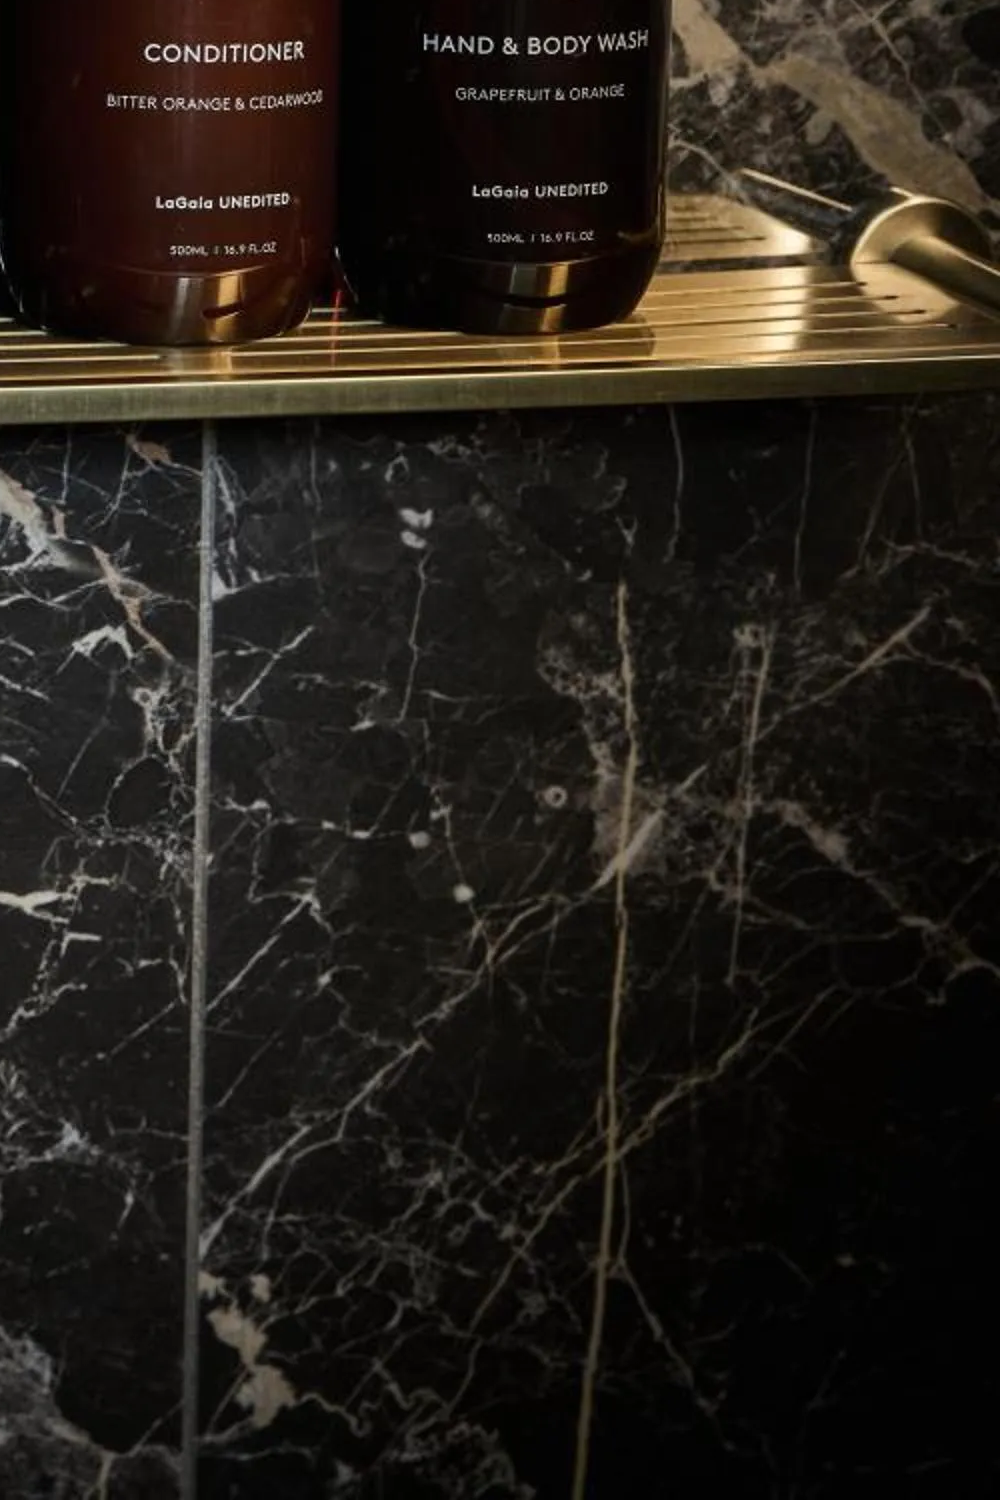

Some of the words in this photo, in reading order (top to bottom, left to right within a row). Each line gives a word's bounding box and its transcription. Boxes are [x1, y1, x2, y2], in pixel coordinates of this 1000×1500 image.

[422, 33, 495, 55] HAND
[502, 36, 520, 56] &
[526, 34, 592, 55] BODY
[598, 29, 649, 53] WASH
[144, 41, 305, 64] CONDITIONER
[455, 86, 552, 102] GRAPEFRUIT
[555, 88, 565, 101] &
[569, 84, 625, 100] ORANGE
[106, 93, 157, 111] BITTER
[162, 96, 231, 112] ORANGE
[235, 97, 245, 112] &
[472, 184, 529, 198] LaGaia
[535, 182, 608, 198] UNEDITED
[155, 195, 213, 209] LaGaia
[219, 192, 290, 209] UNEDITED
